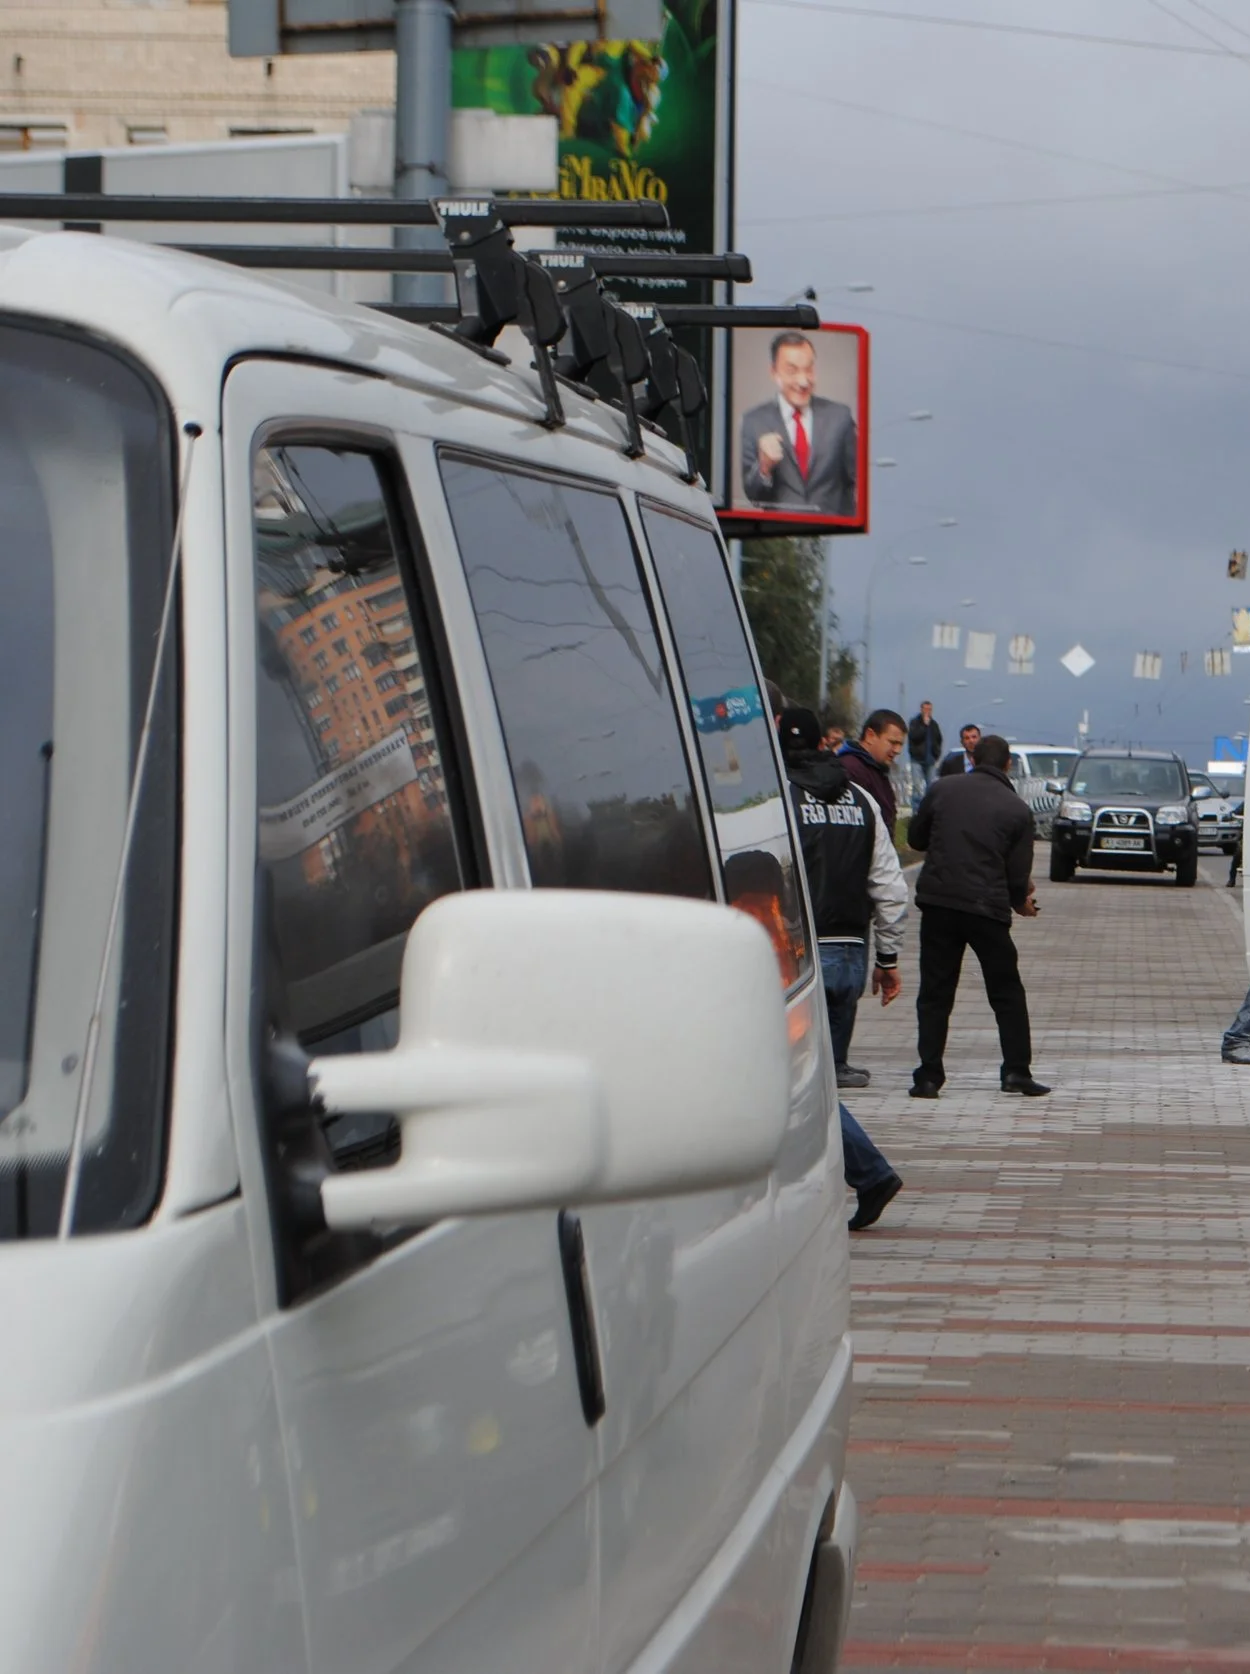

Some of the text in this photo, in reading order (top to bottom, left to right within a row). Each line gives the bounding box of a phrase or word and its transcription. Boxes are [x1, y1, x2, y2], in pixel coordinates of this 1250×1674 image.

[438, 202, 489, 216] THULE
[539, 254, 584, 268] THULE
[826, 804, 865, 826] DENIM
